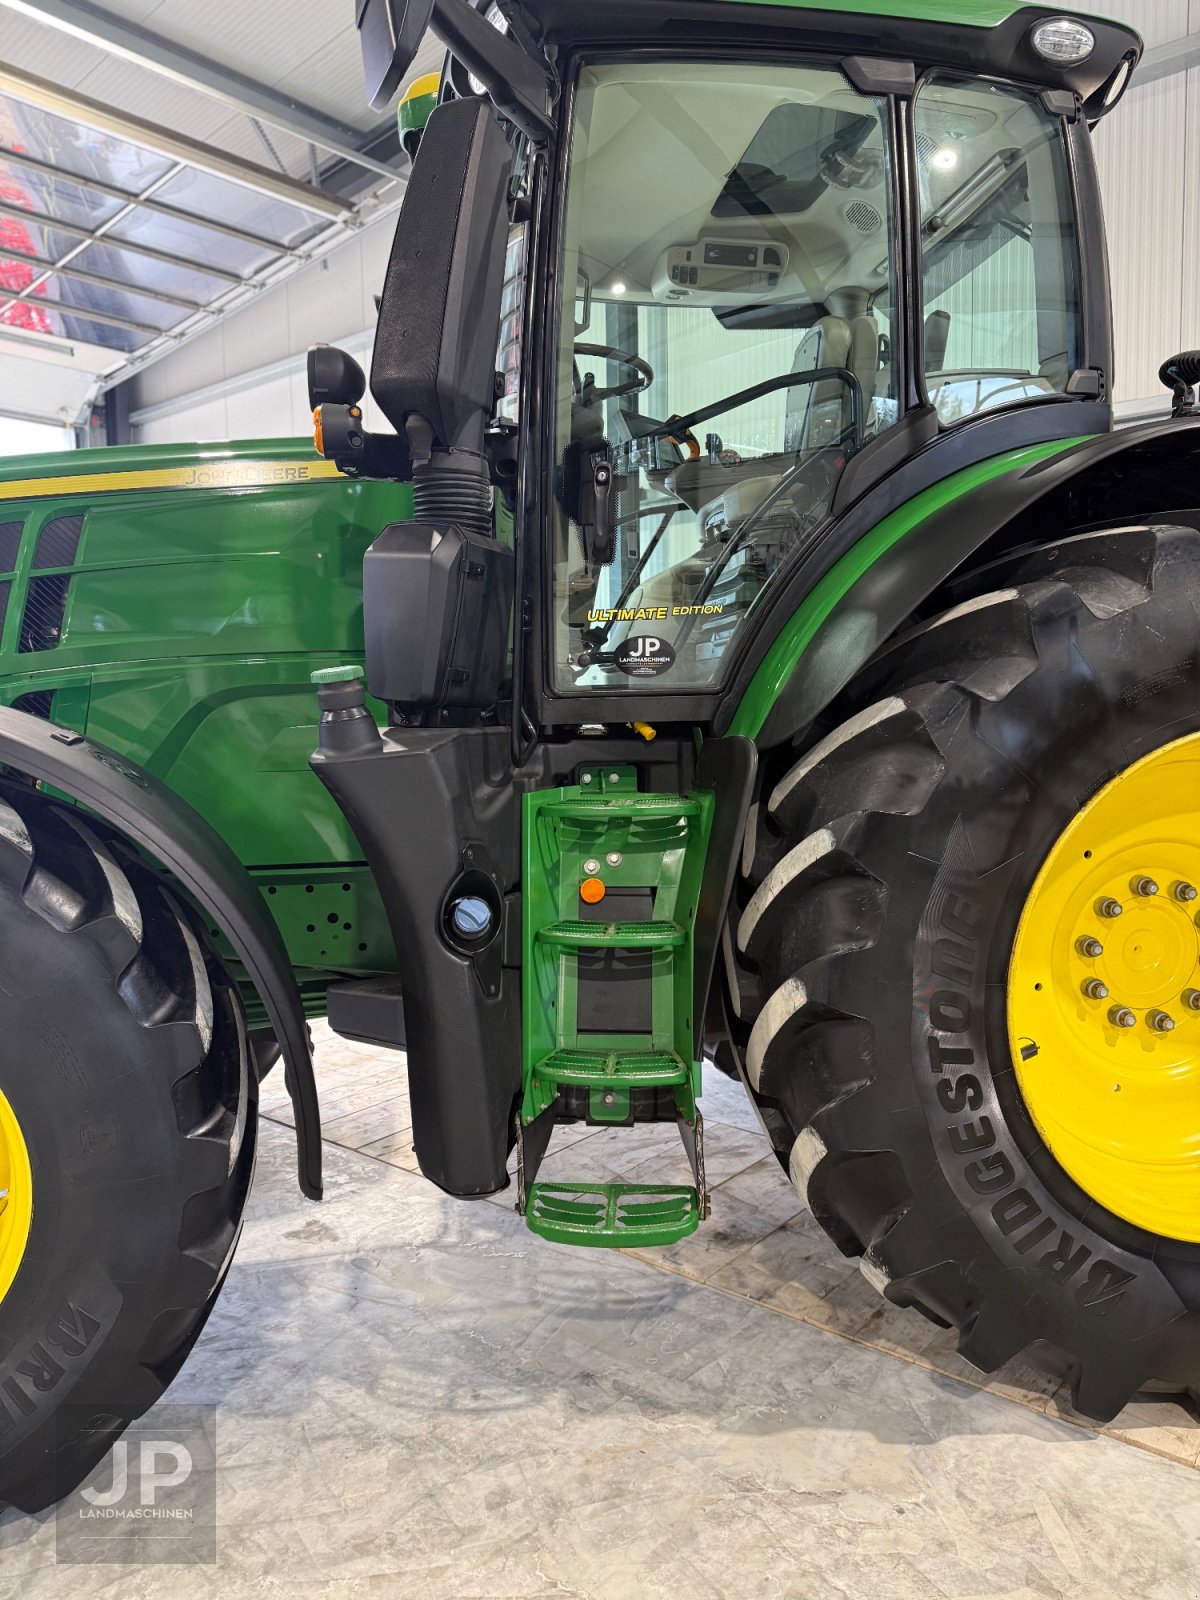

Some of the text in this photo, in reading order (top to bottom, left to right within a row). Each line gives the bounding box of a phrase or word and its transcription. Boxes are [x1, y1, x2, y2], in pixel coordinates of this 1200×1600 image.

[587, 604, 724, 622] ULTIMATE EDITION
[629, 637, 661, 657] JP
[928, 891, 1138, 1314] BRIDGESTONE
